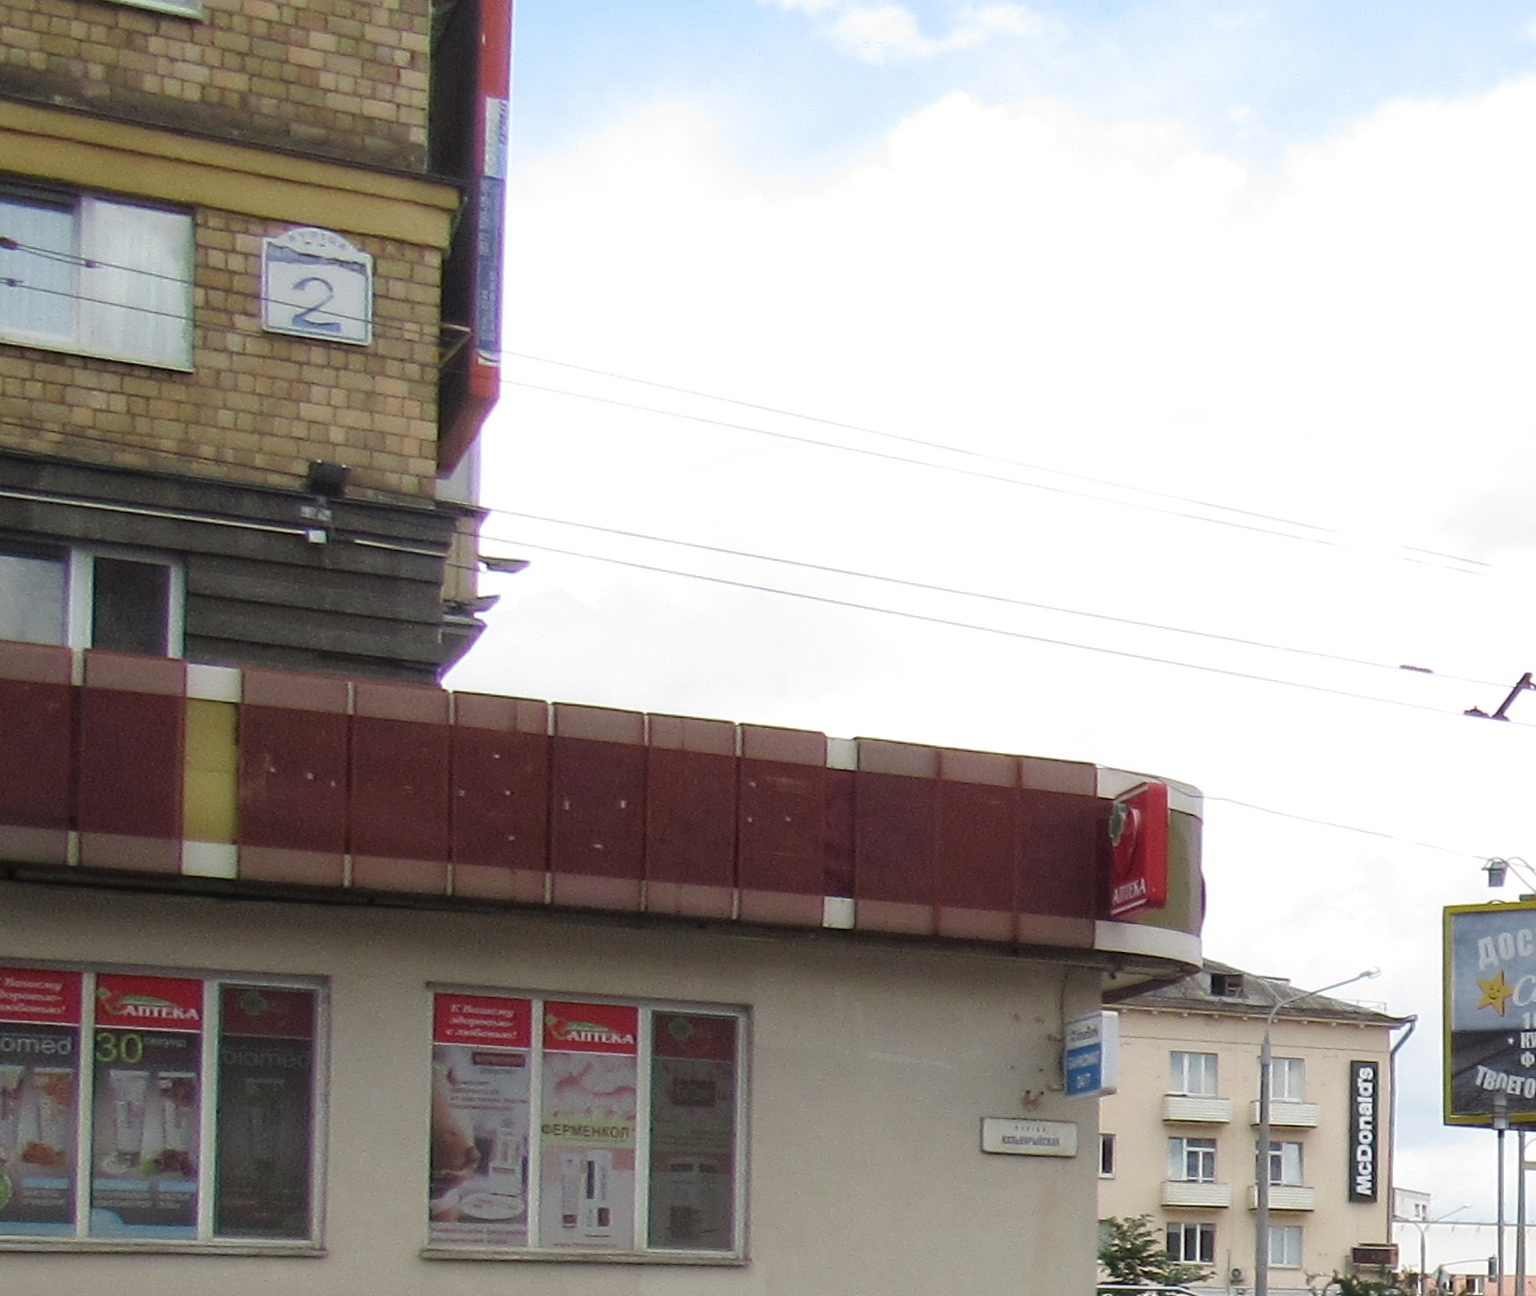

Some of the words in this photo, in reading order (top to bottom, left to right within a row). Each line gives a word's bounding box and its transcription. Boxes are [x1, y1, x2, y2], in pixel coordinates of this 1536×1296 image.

[292, 276, 342, 332] 2
[121, 1005, 200, 1021] АПТЕКА
[567, 1031, 635, 1045] АПТЕКА
[96, 1032, 143, 1063] 30
[541, 1124, 630, 1140] ФЕРМЕНКОЛ
